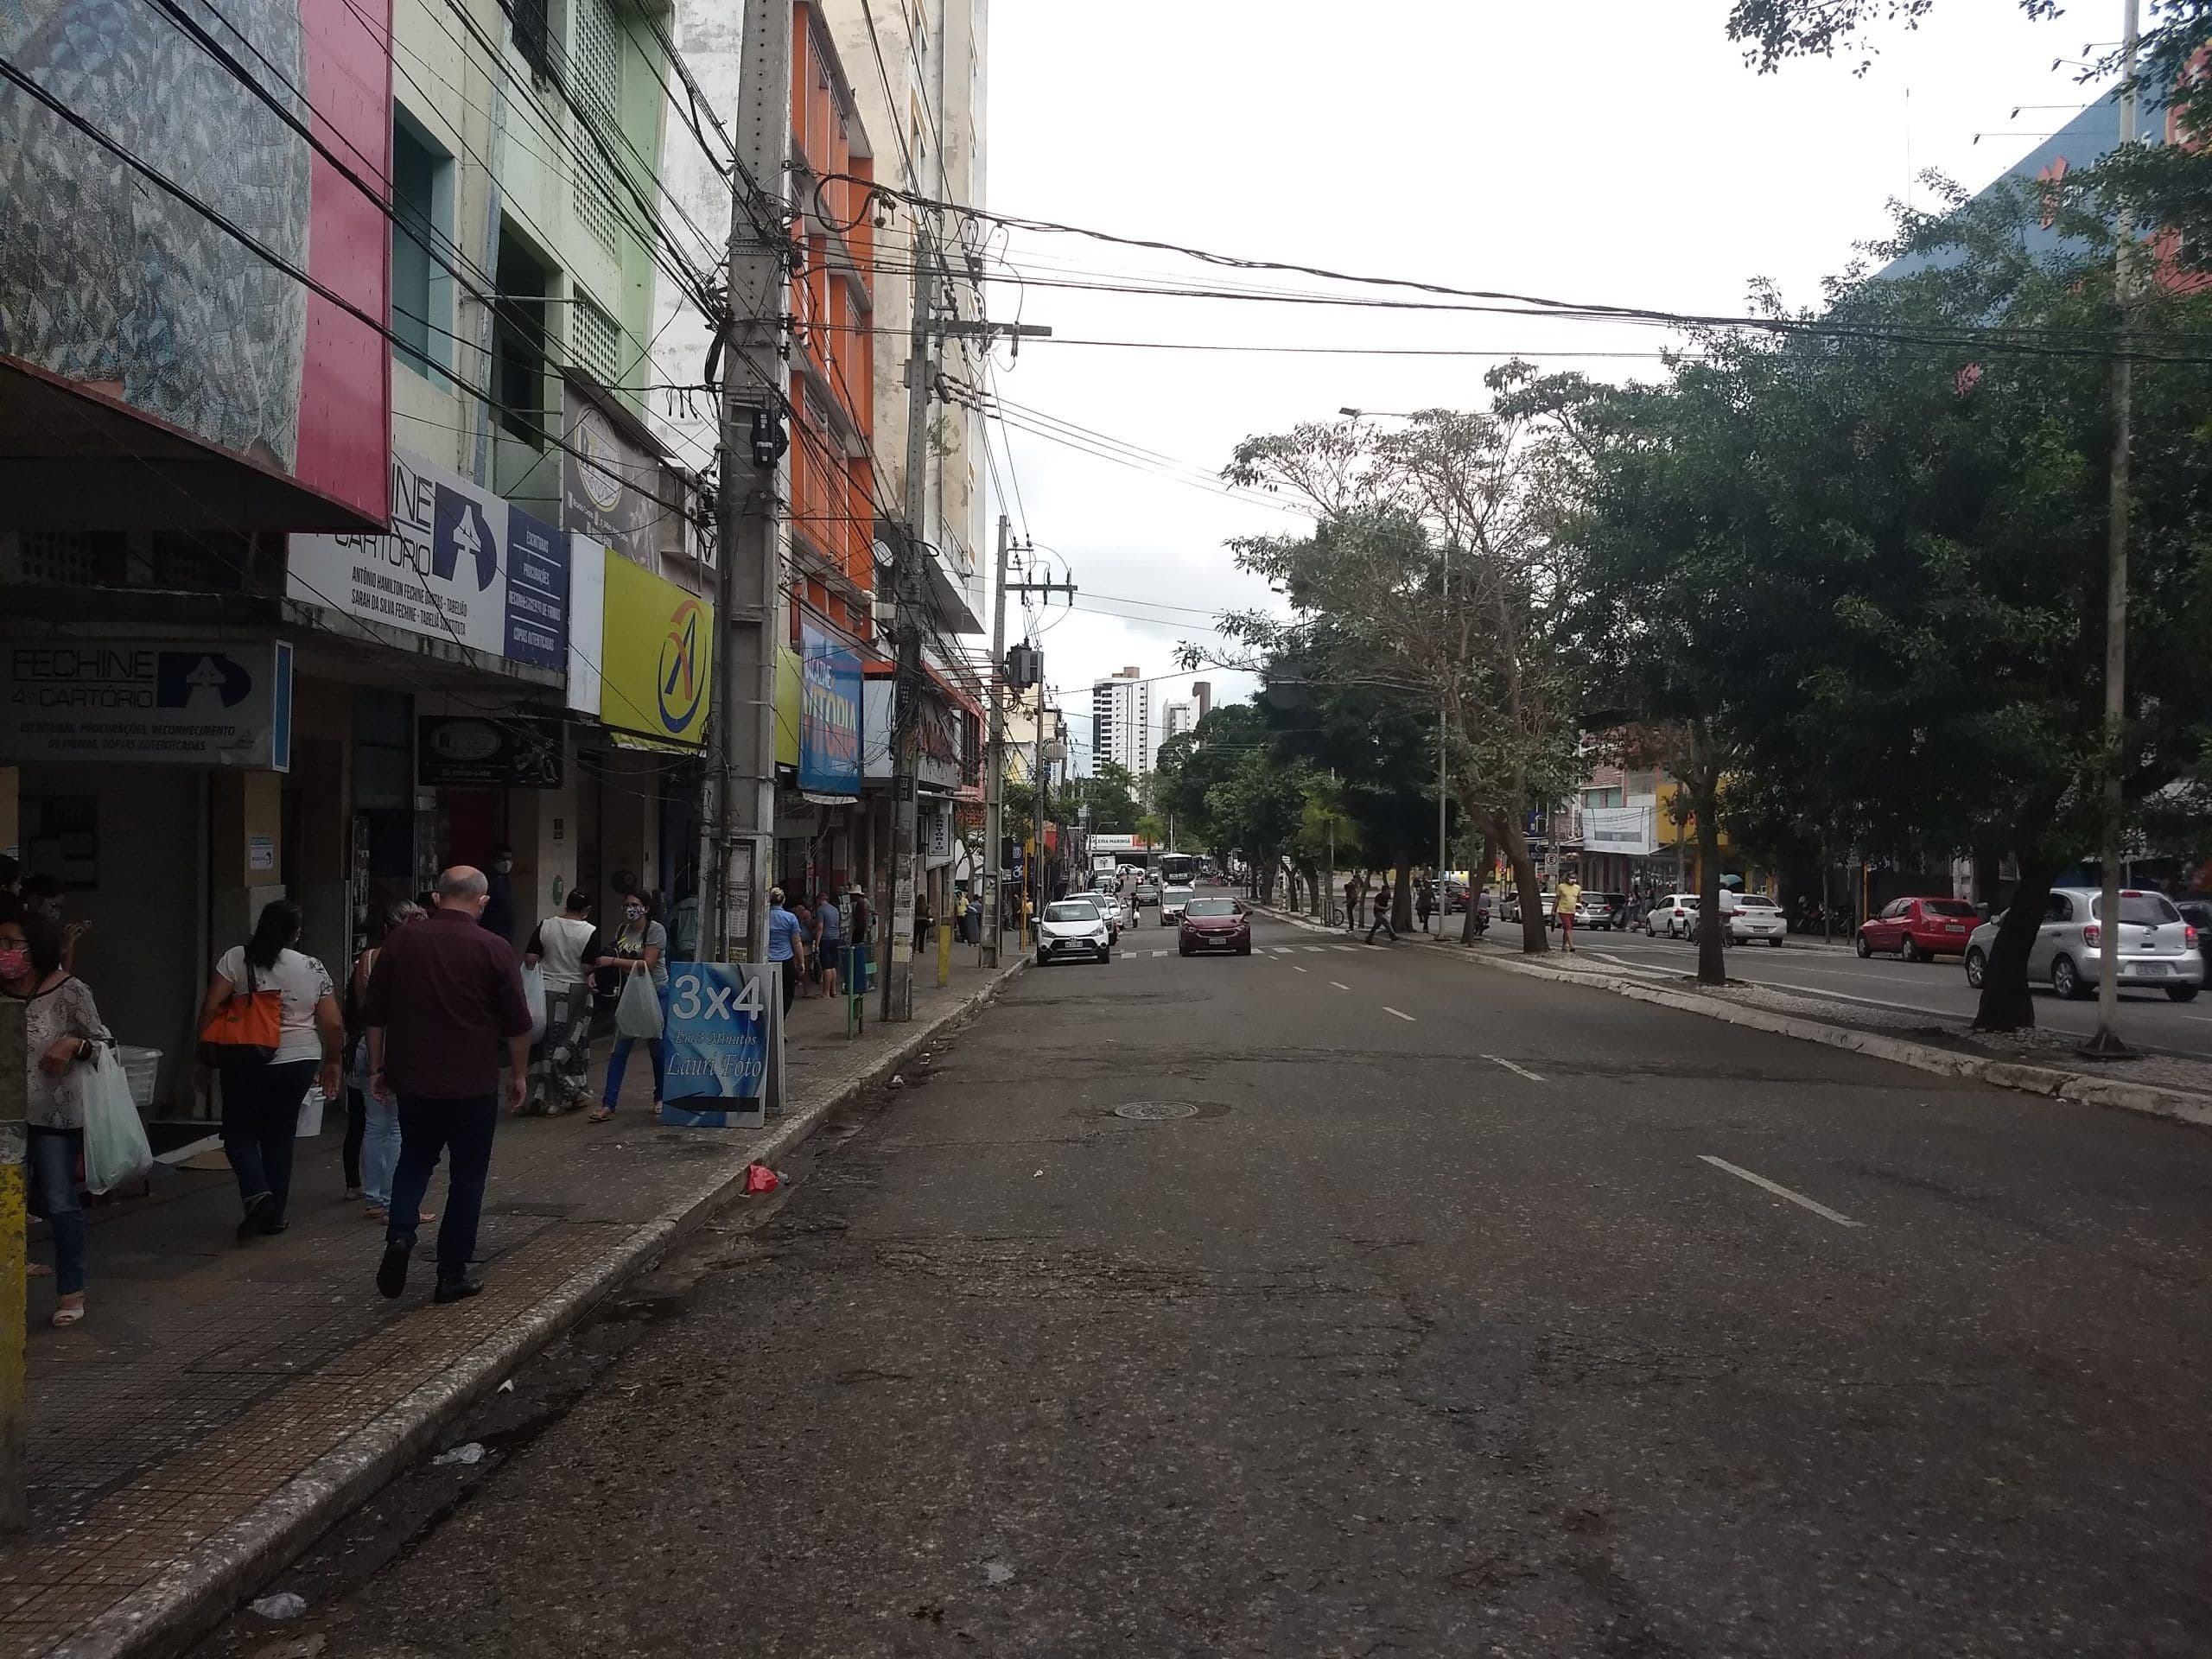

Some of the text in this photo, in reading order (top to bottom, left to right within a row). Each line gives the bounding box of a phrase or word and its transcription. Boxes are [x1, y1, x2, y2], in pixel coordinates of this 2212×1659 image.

[391, 463, 432, 526] INE
[352, 588, 371, 609] SARAH
[372, 594, 379, 612] DA
[379, 598, 394, 617] SILVA
[395, 602, 416, 622] FECHINE
[377, 575, 404, 596] HAMILTON
[404, 584, 424, 604] FECHINE
[447, 598, 467, 618] TABELIÃO
[14, 649, 154, 678] FECHINE
[40, 684, 153, 708] CARTÓRIO
[151, 725, 235, 736] RECONHECIMENTO
[138, 739, 207, 751] AUTENTICADAS
[672, 974, 765, 1021] 3x4
[676, 1031, 695, 1045] Em
[707, 1031, 758, 1046] Minutos
[666, 1052, 762, 1077] Lauri Foto
